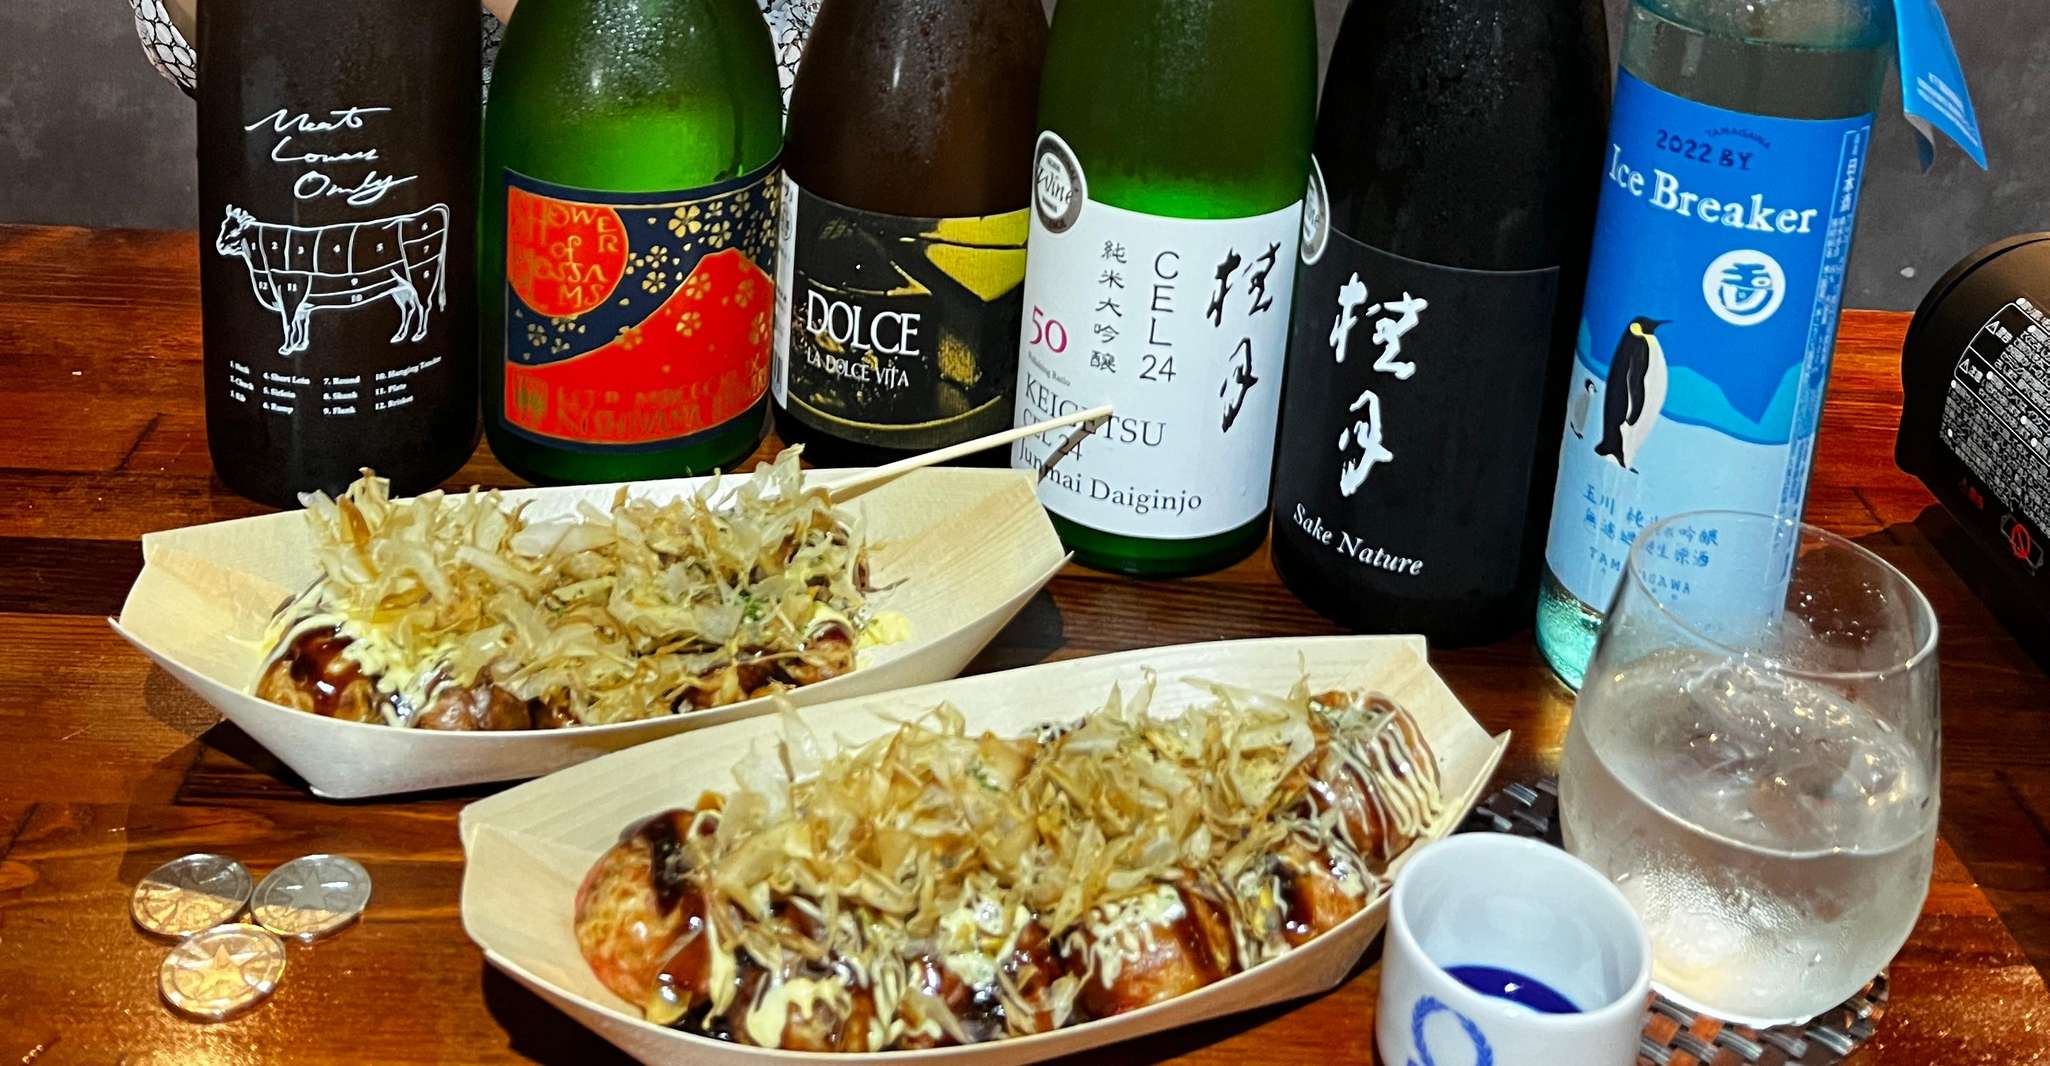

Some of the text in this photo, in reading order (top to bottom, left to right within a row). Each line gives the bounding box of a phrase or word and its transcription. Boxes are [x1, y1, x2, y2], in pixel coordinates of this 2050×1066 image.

[1656, 128, 1754, 171] 2022 BY
[294, 170, 418, 206] Only
[1608, 143, 1818, 234] Ice Breaker
[806, 289, 921, 356] DOLCE
[1029, 304, 1068, 354] 50
[1090, 240, 1127, 374] 純米大吟醸
[1139, 250, 1180, 383] CEL 24
[825, 353, 870, 382] DOLCE
[1025, 371, 1167, 447] KEIGTSU
[1089, 476, 1203, 517] Daiginjo
[1292, 502, 1425, 576] Sake Nature
